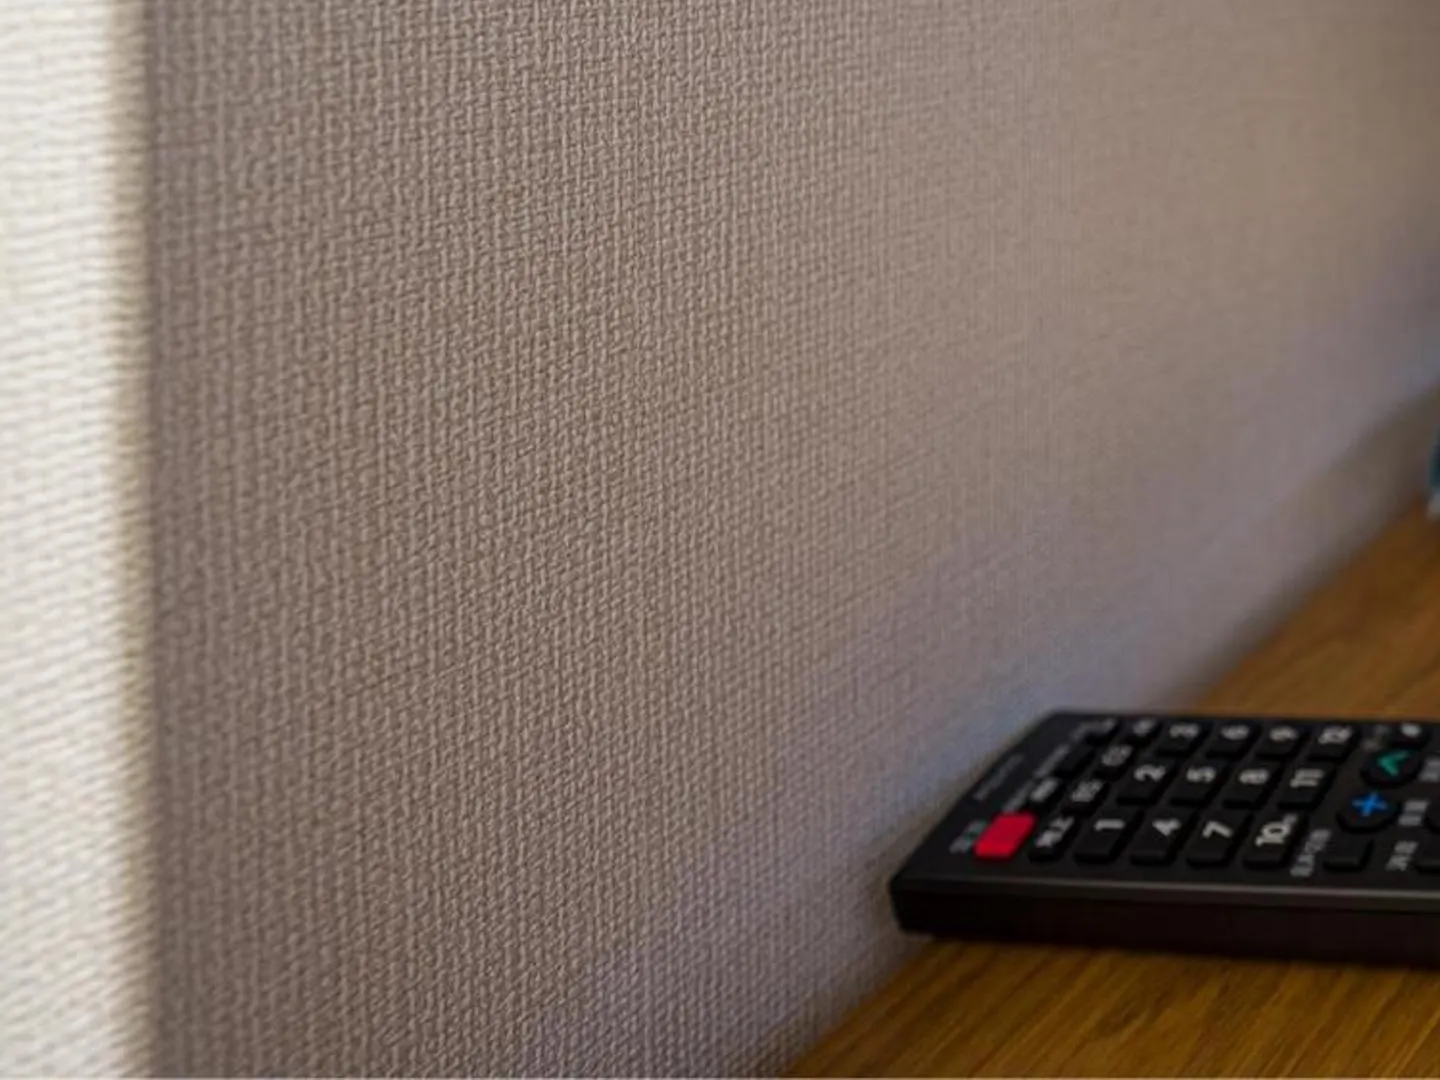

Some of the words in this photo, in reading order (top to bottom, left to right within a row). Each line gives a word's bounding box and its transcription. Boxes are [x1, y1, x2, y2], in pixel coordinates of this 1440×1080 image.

[1133, 764, 1166, 782] 2
[1290, 769, 1324, 788] 11
[1093, 818, 1125, 831] 1
[1152, 818, 1181, 837] 4
[1202, 821, 1233, 838] 7
